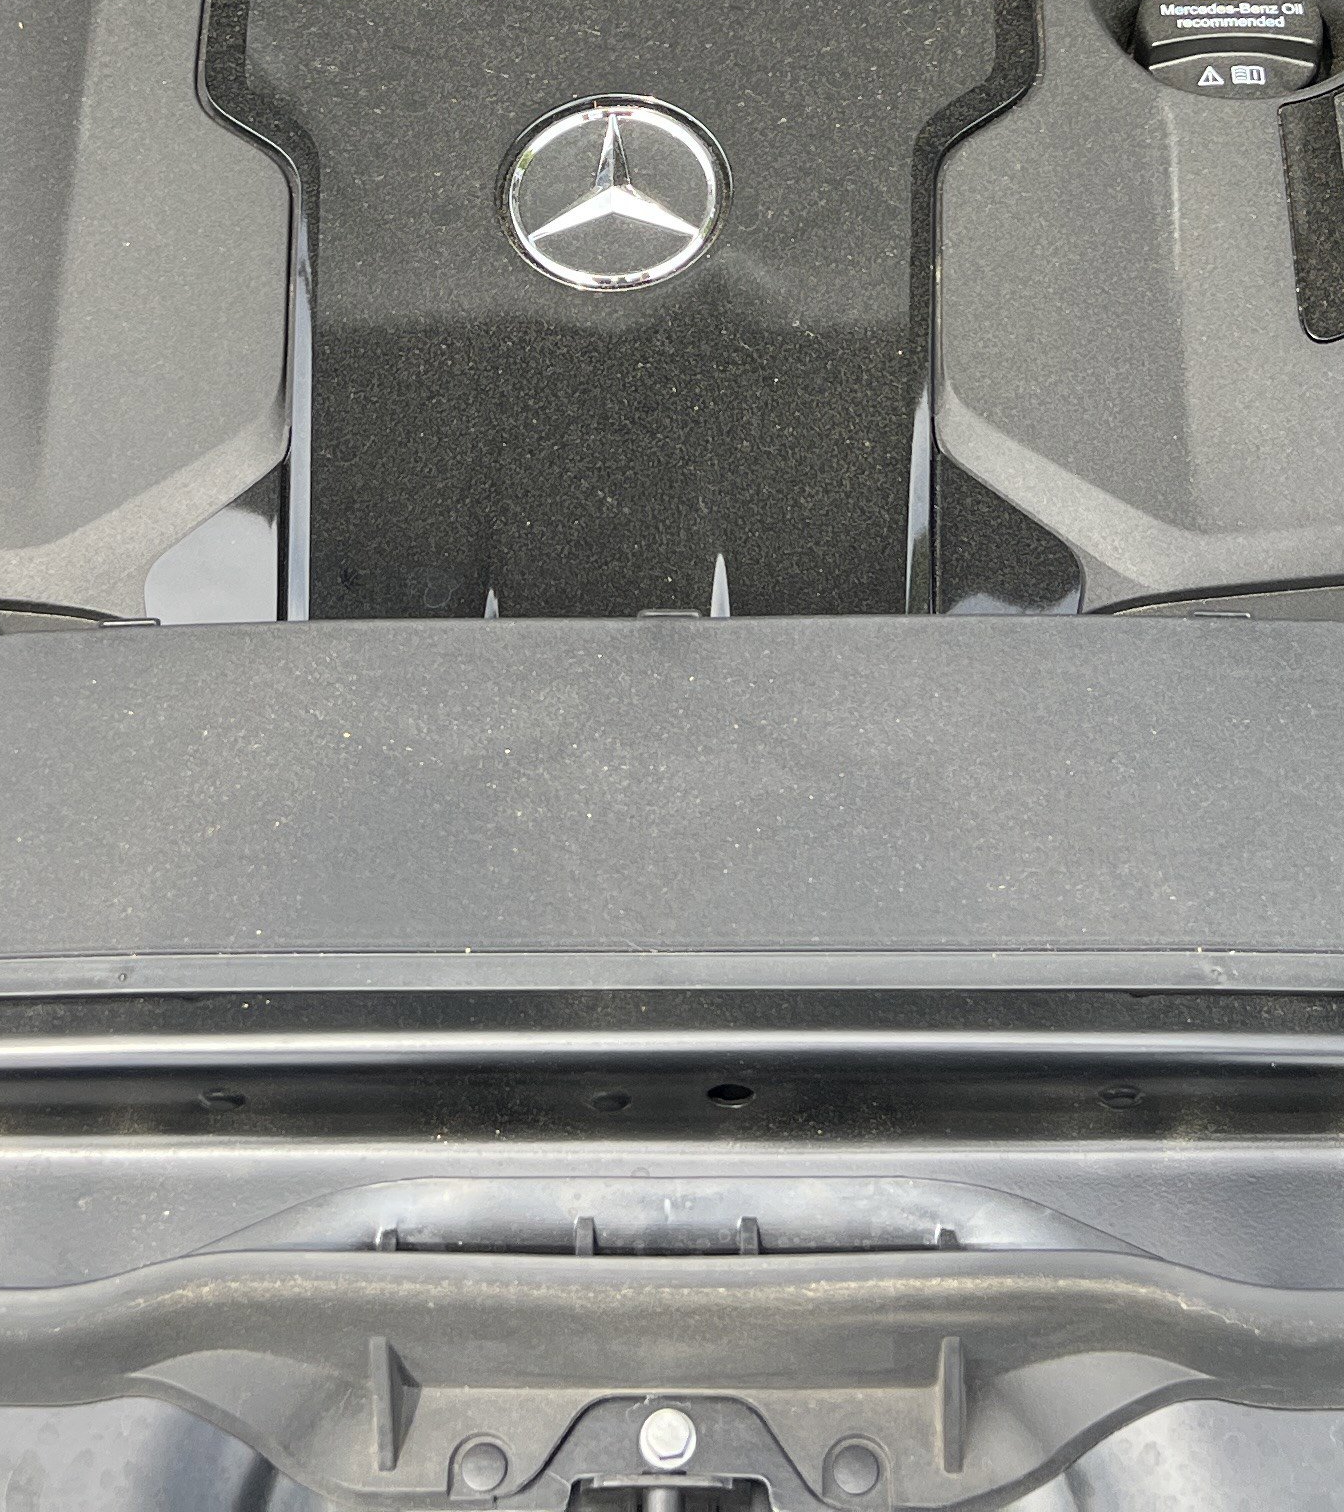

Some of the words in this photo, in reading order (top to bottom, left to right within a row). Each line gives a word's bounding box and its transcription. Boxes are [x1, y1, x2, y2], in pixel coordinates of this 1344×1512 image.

[1159, 2, 1279, 16] Mercedes-Benz
[1281, 2, 1304, 15] Oil
[1176, 16, 1285, 28] recommended
